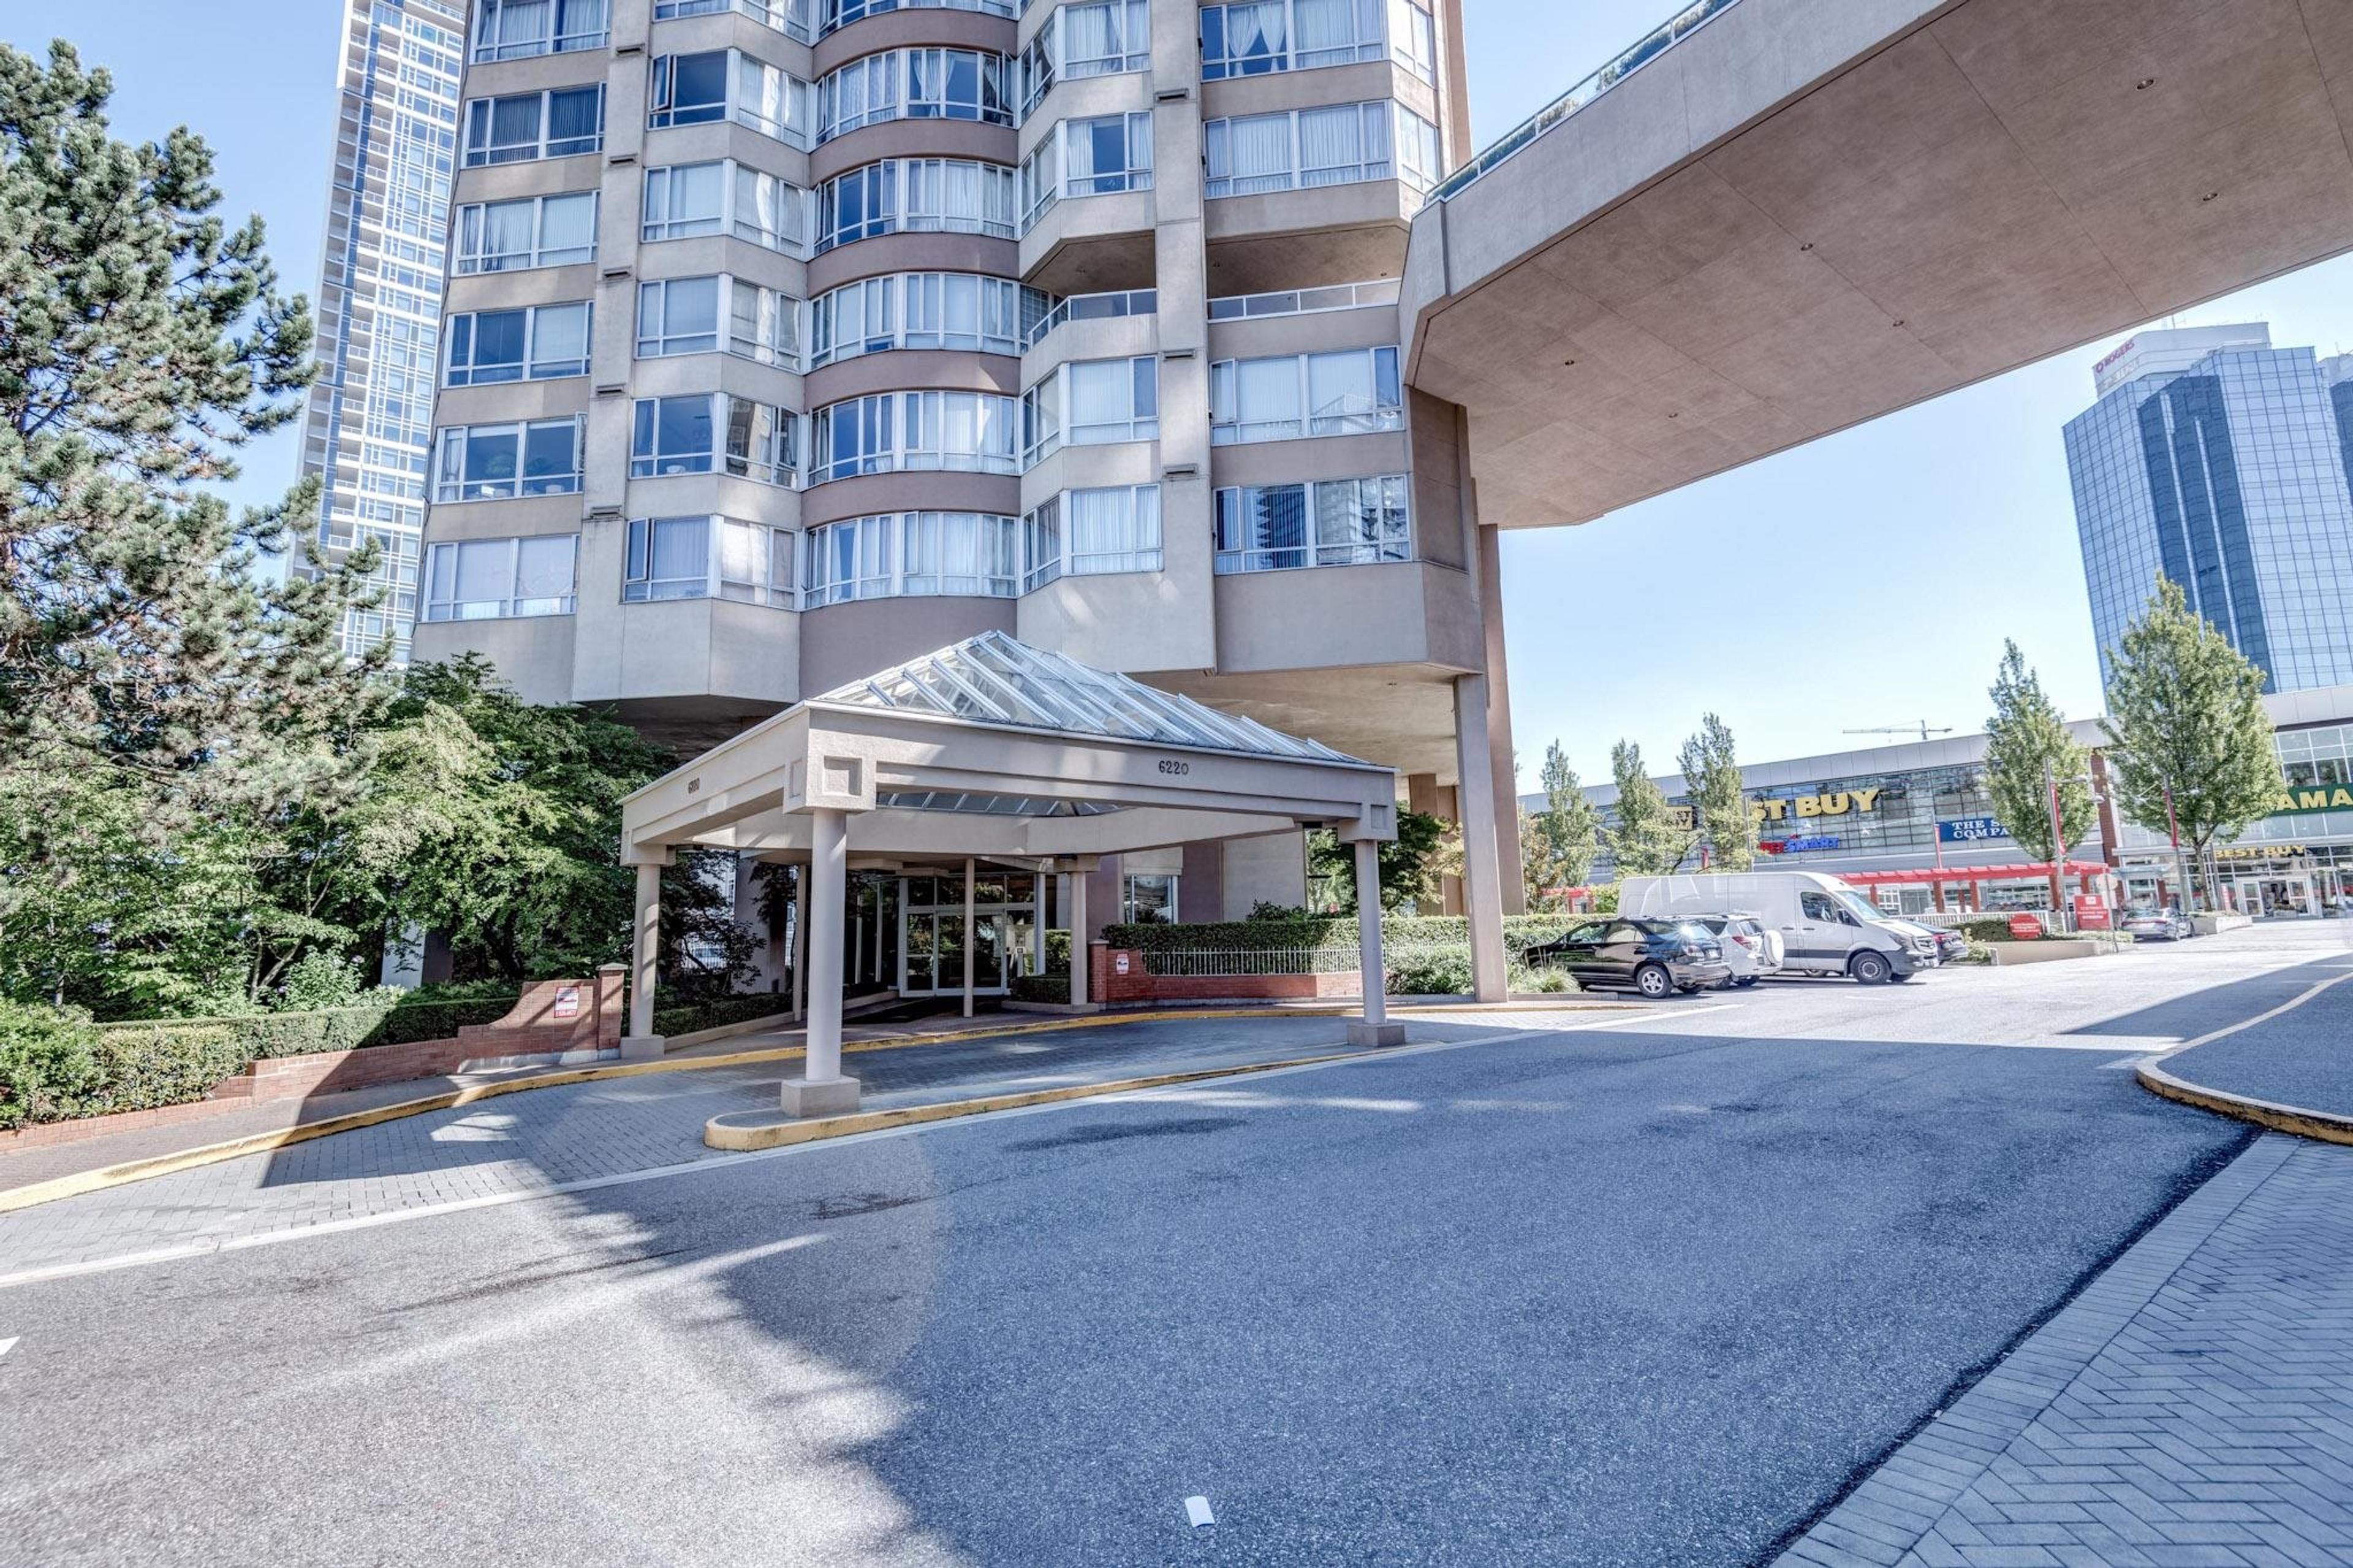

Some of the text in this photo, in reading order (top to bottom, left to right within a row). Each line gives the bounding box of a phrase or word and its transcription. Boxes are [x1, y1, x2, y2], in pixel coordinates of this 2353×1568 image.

[1159, 760, 1189, 776] 6220
[1749, 789, 1880, 820] ST BUY
[1952, 820, 1985, 830] THE
[1953, 827, 2010, 839] COMPA
[2215, 844, 2306, 858] BEST BUY
